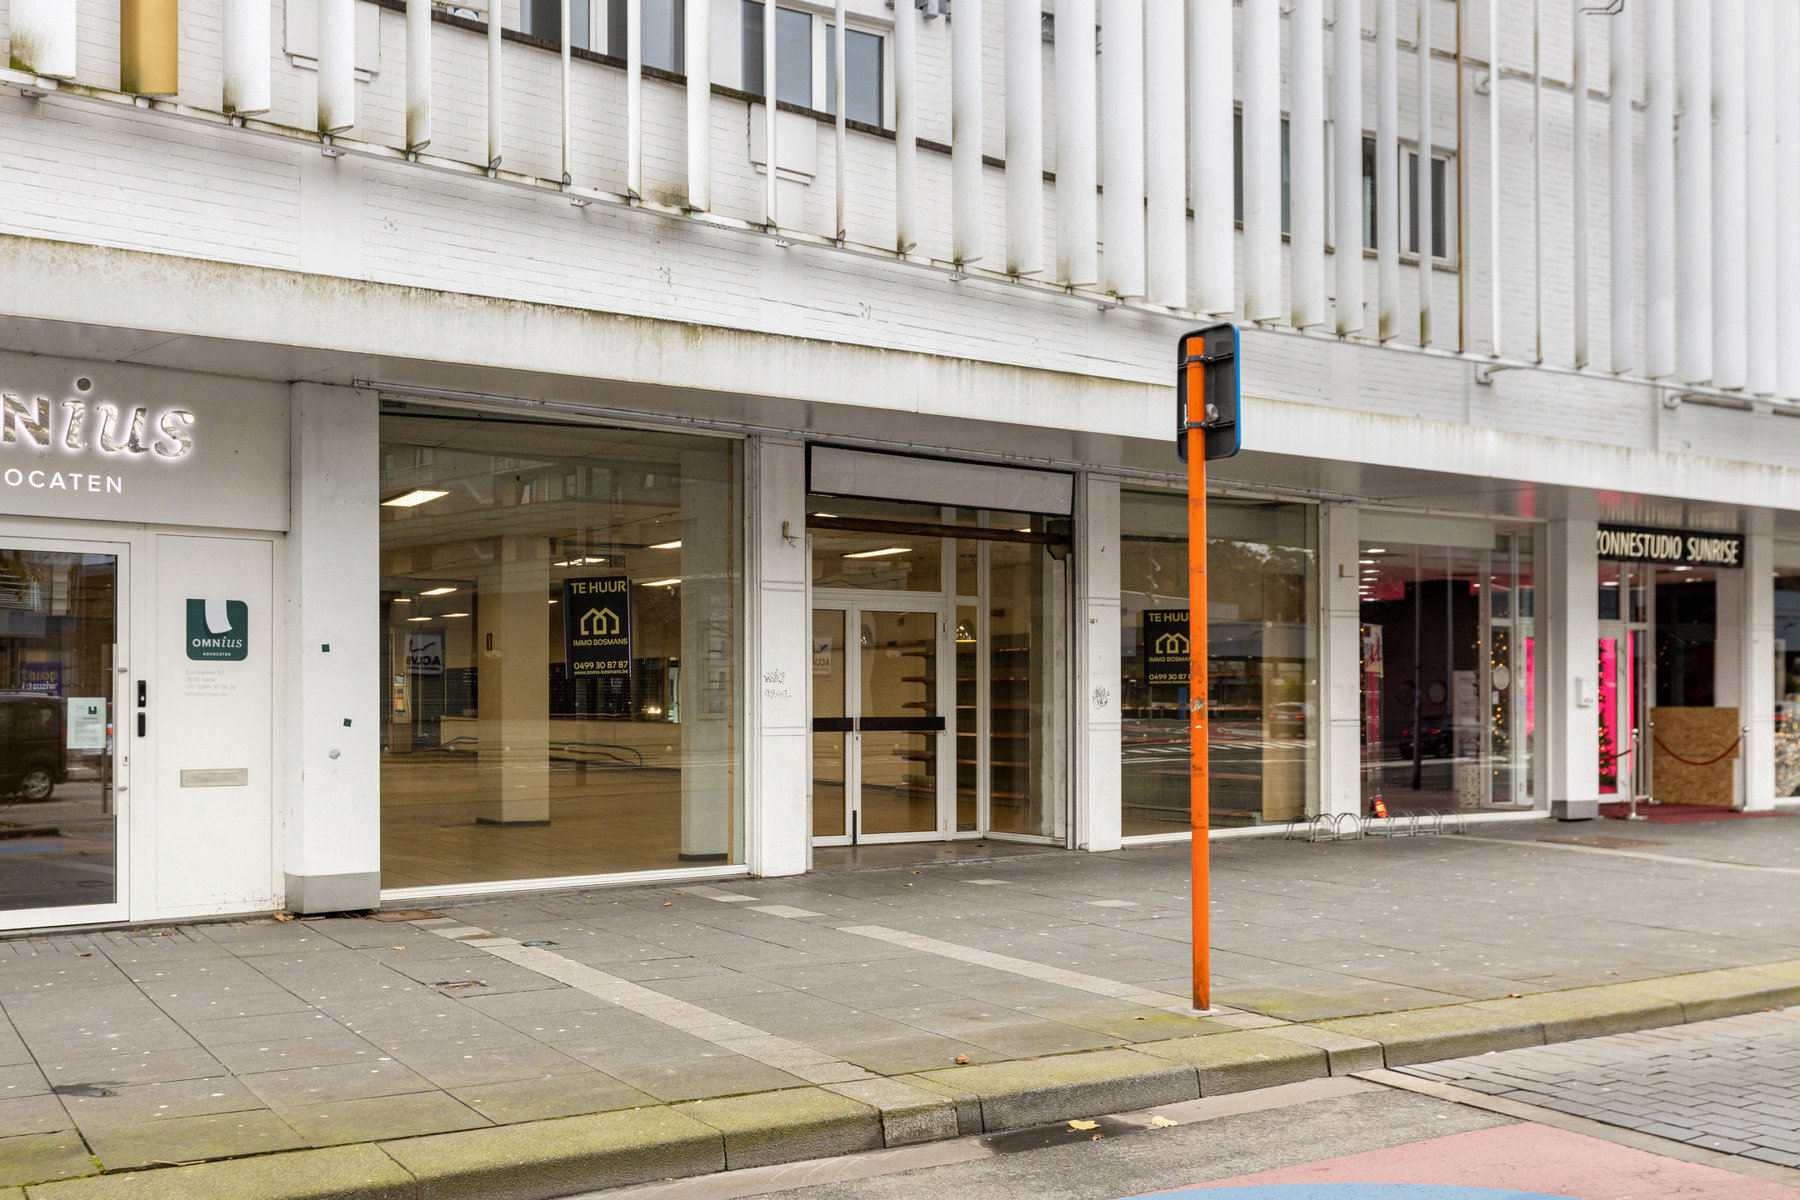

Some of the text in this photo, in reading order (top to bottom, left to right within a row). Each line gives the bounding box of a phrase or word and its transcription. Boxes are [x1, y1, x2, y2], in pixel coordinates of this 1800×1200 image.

[4, 468, 122, 494] OCATEN
[1686, 536, 1739, 564] SUNRISE
[571, 580, 627, 594] TE HUUR
[1148, 612, 1189, 622] TE HUU
[192, 636, 243, 648] OMNius
[573, 637, 628, 647] IMMO BOSMANS
[573, 660, 629, 670] 0499 30 87 87
